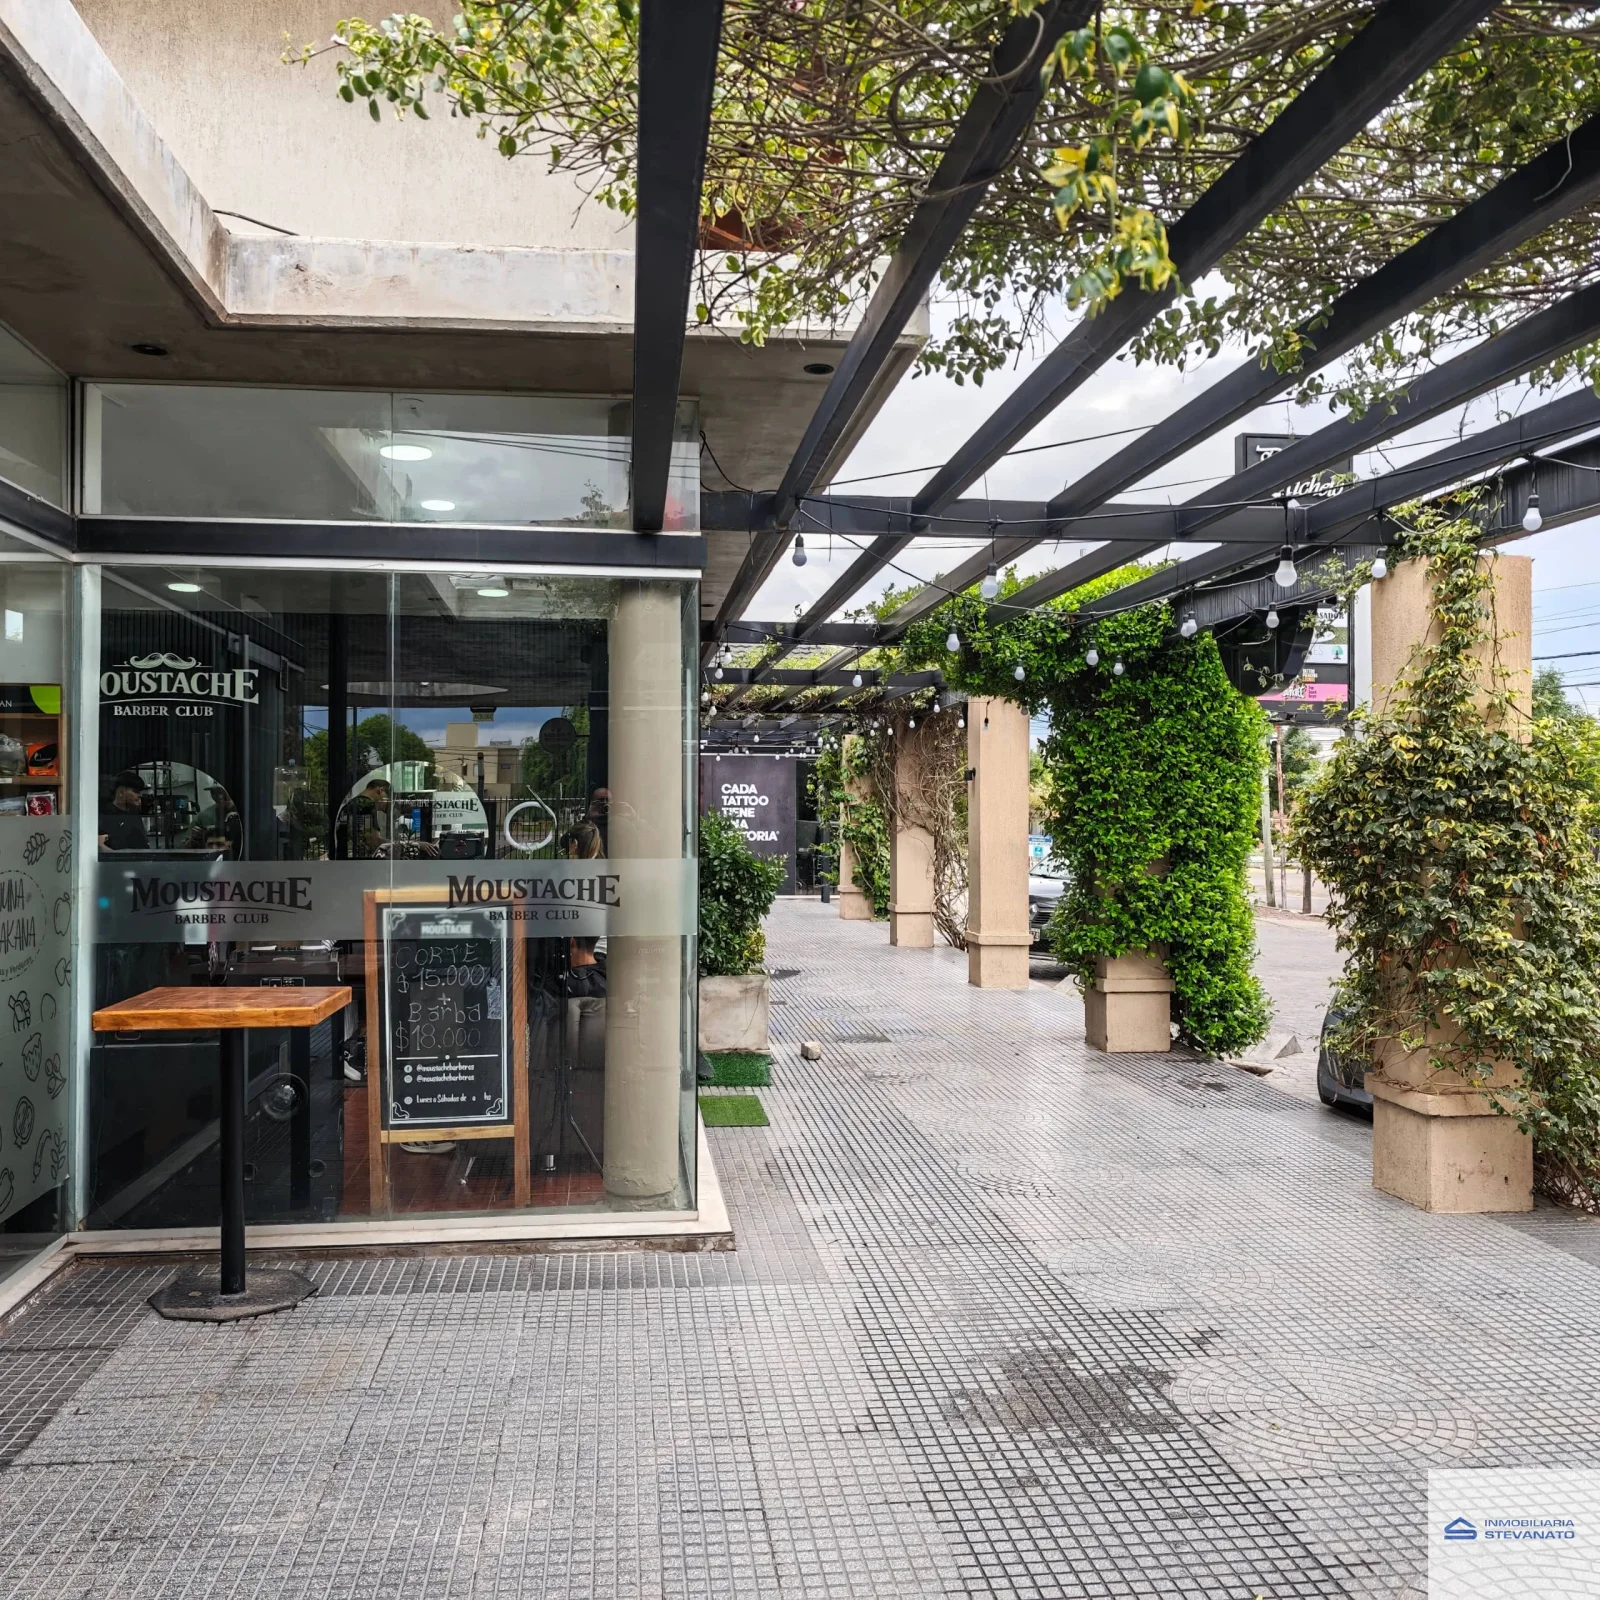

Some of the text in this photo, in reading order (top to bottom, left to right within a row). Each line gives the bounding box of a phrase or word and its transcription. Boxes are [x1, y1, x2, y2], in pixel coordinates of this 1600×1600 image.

[100, 668, 260, 704] OUSTACHE
[113, 705, 214, 717] BARBER CLUB
[721, 783, 758, 794] CADA
[721, 795, 769, 806] TATTOO
[730, 819, 749, 829] NA
[130, 877, 313, 913] MOUSTACHE
[446, 874, 621, 909] MOUSTACHE
[174, 912, 269, 925] BARBER CLUB
[489, 909, 580, 921] BARBER CLUB
[395, 942, 479, 969] CORTE
[408, 1001, 481, 1024] Barba
[416, 1095, 432, 1103] Lunes
